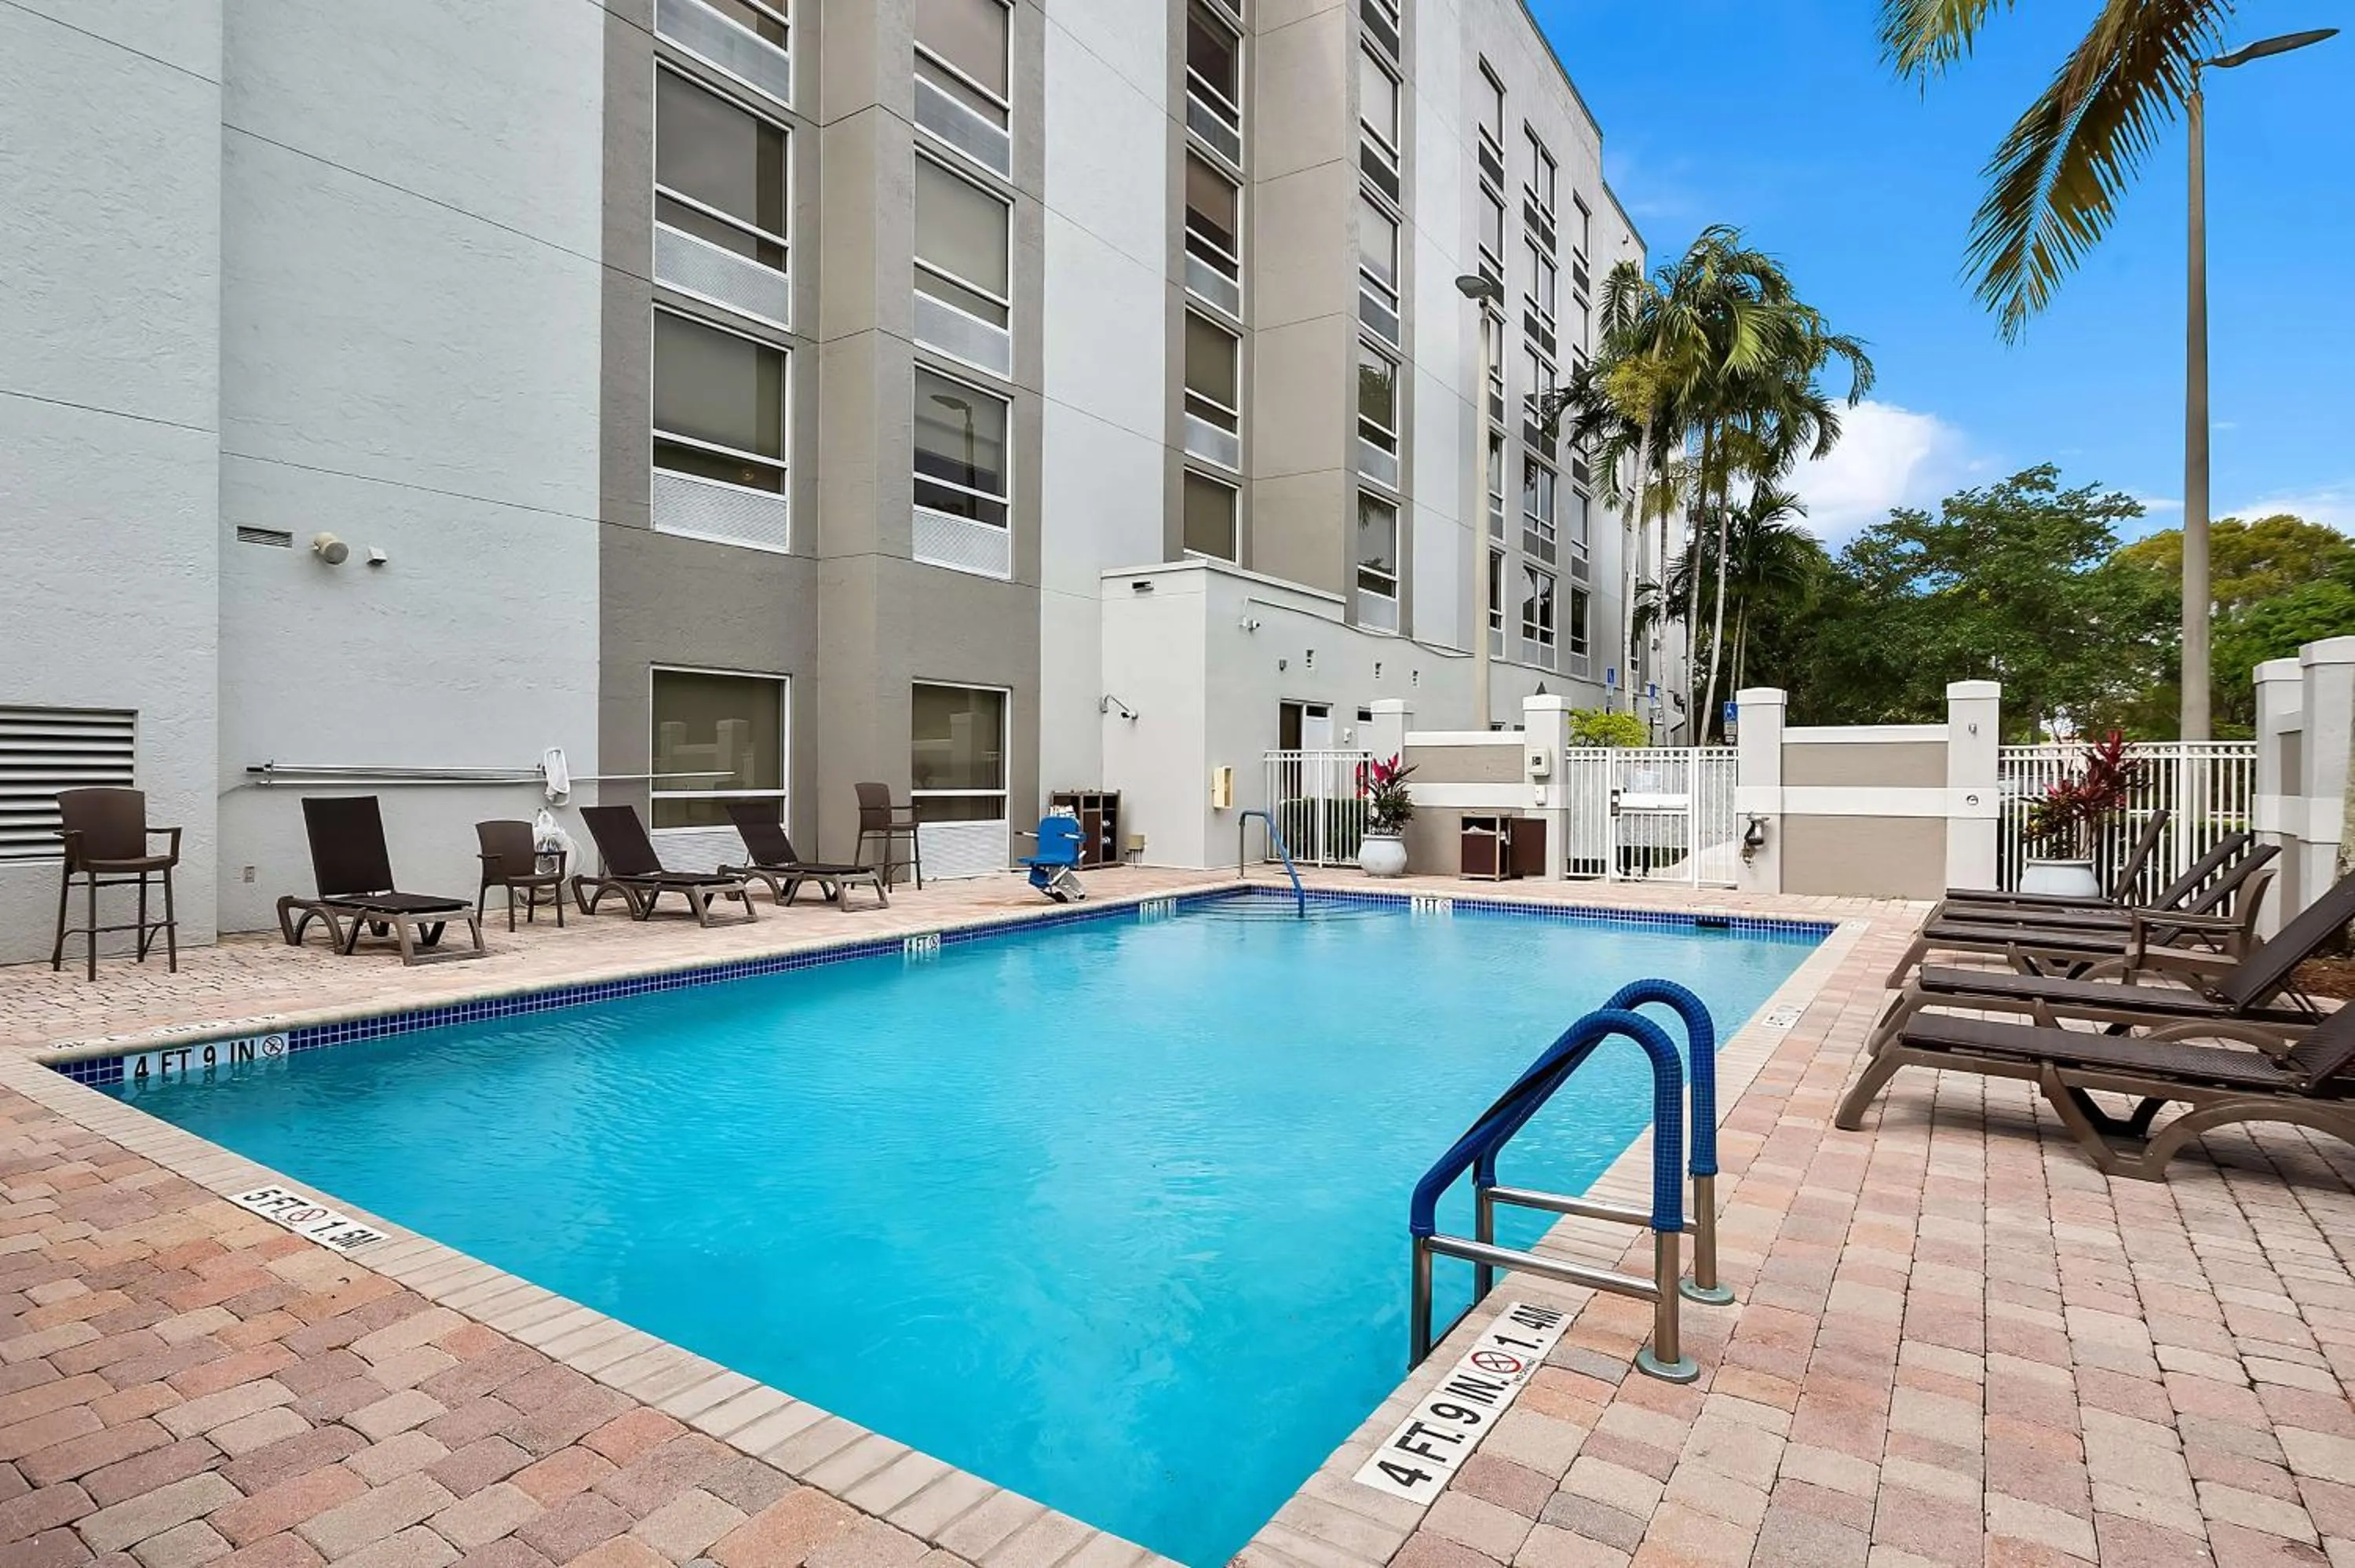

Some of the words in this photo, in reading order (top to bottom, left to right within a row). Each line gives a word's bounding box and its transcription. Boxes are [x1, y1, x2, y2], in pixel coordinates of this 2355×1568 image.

[1425, 899, 1438, 913] FT
[917, 936, 928, 953] FT
[134, 1056, 149, 1078] 4
[161, 1048, 192, 1077] FT
[203, 1045, 217, 1067] 9
[230, 1039, 255, 1063] IN
[243, 1189, 282, 1202] 5
[1444, 1373, 1510, 1404] IN.
[1429, 1402, 1481, 1424] 9
[1393, 1421, 1466, 1463] FT.
[1377, 1460, 1433, 1487] 4
